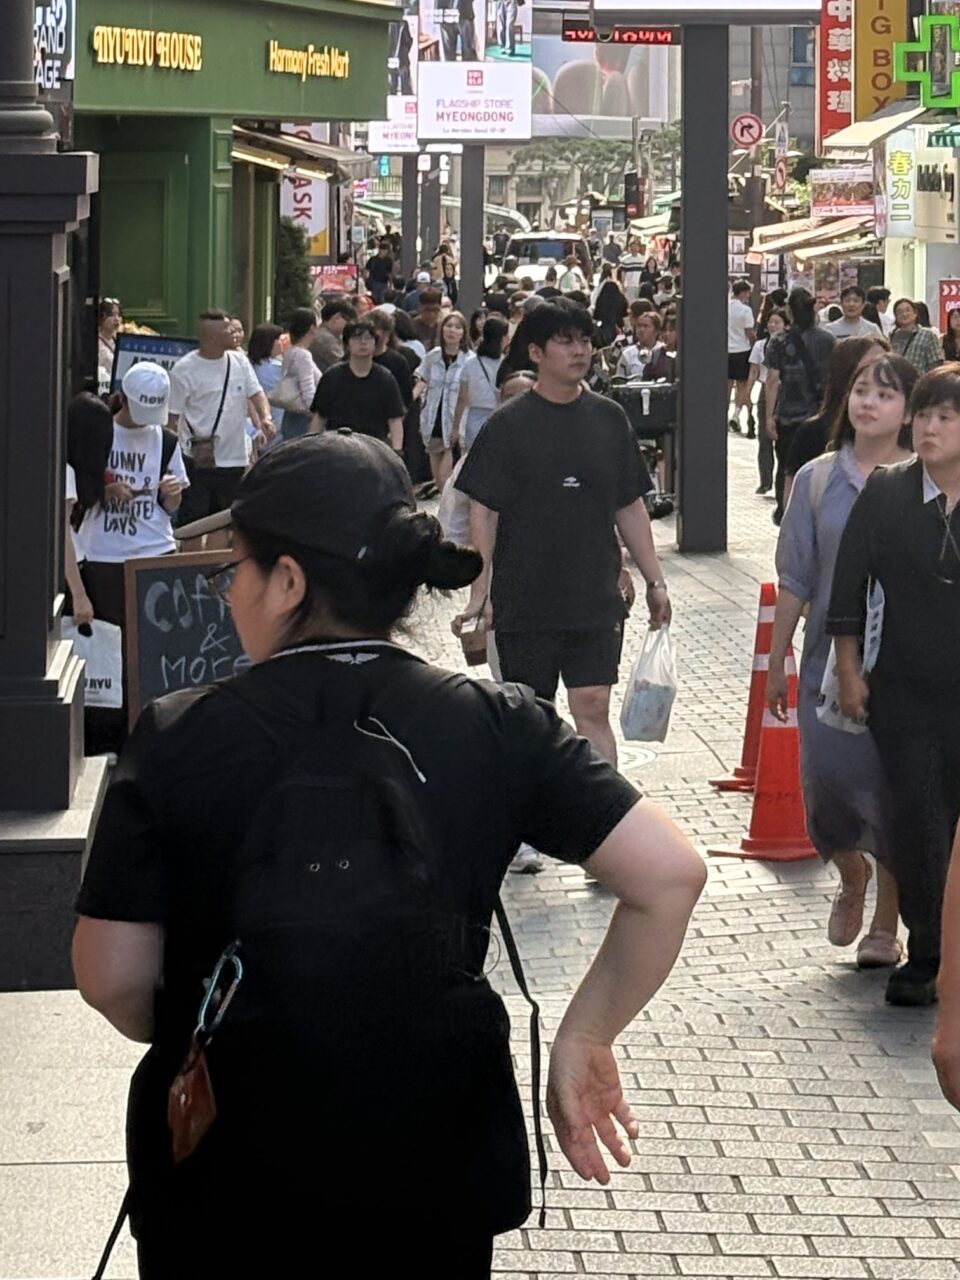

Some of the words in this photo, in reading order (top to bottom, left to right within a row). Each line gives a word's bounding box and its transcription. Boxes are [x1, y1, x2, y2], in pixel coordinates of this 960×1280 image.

[156, 31, 202, 71] HOUSE
[268, 39, 307, 82] Harmony
[308, 43, 331, 77] Fresh
[331, 46, 350, 78] Mart
[870, 49, 892, 114] BOX
[436, 111, 514, 122] MYEONGDONG
[110, 450, 146, 473] UNNY
[199, 622, 231, 654] &
